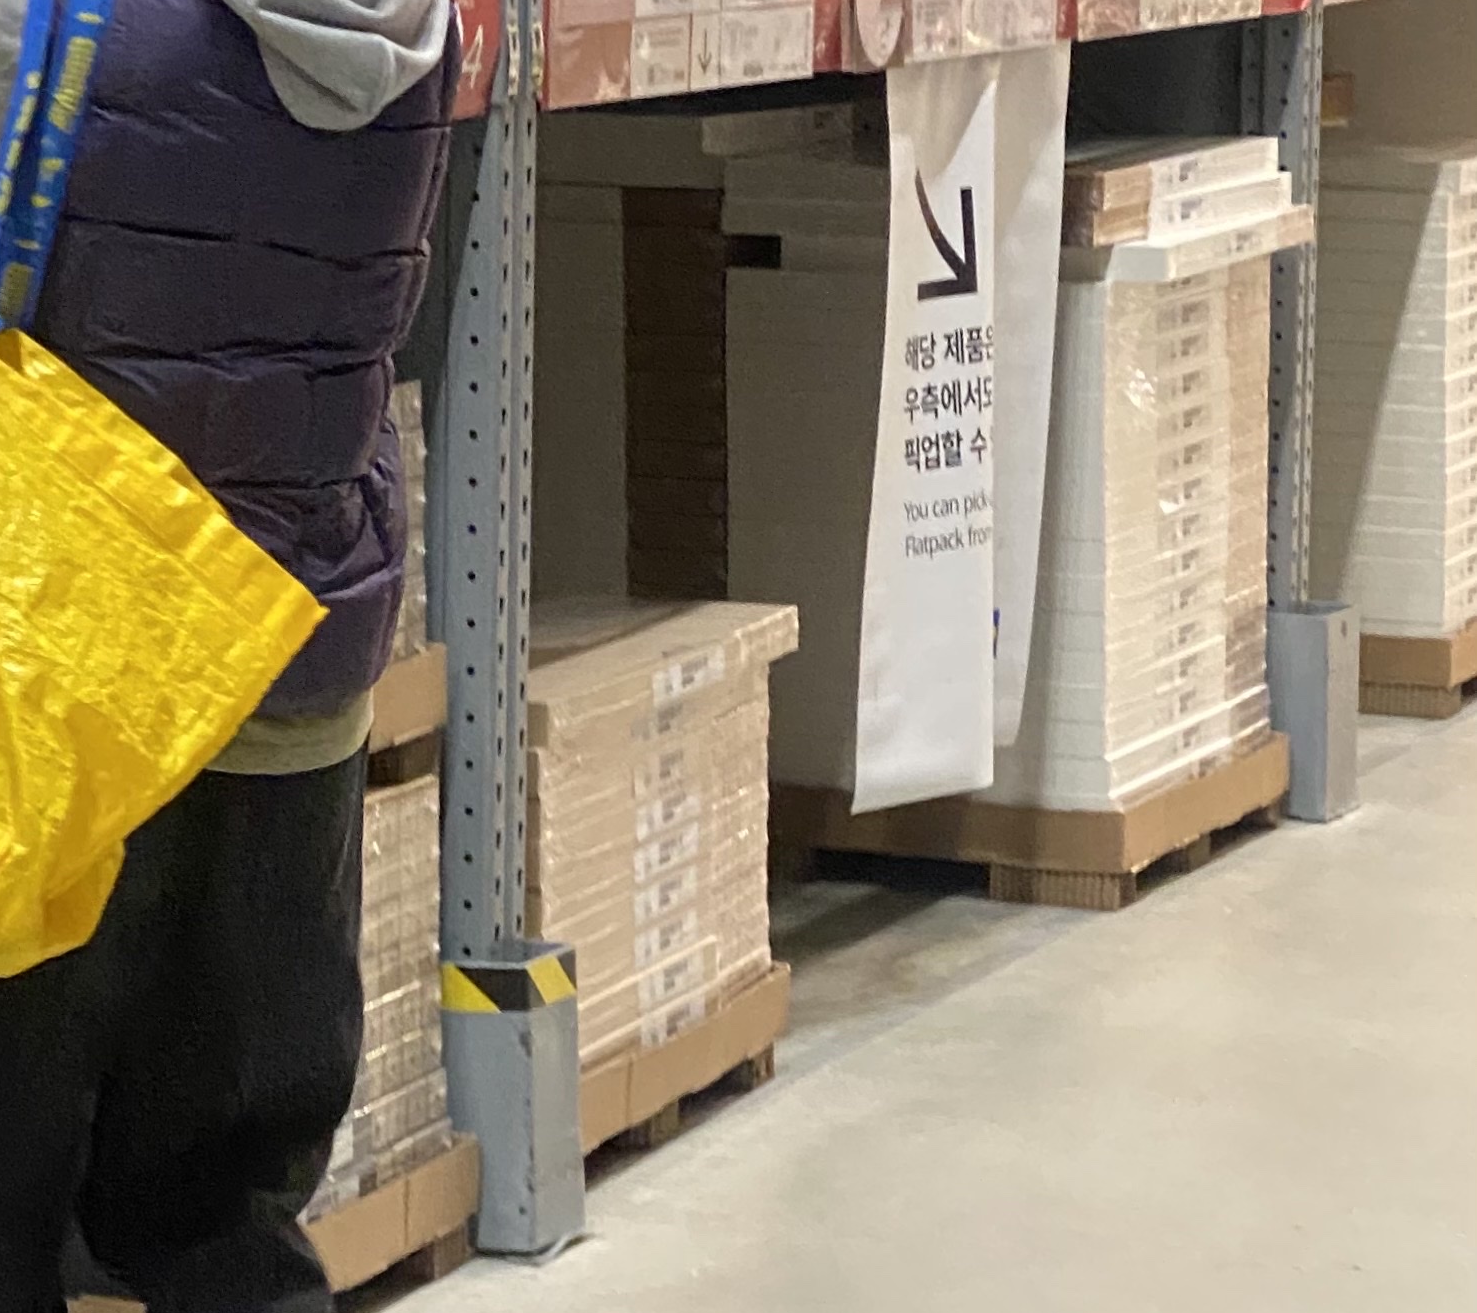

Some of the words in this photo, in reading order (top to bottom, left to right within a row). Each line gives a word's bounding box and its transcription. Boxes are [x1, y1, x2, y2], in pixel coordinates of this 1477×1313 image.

[461, 23, 484, 89] 4
[905, 331, 937, 372] 해당
[904, 429, 963, 473] 픽업할
[969, 427, 988, 465] 수
[903, 501, 929, 523] You
[932, 497, 960, 518] can
